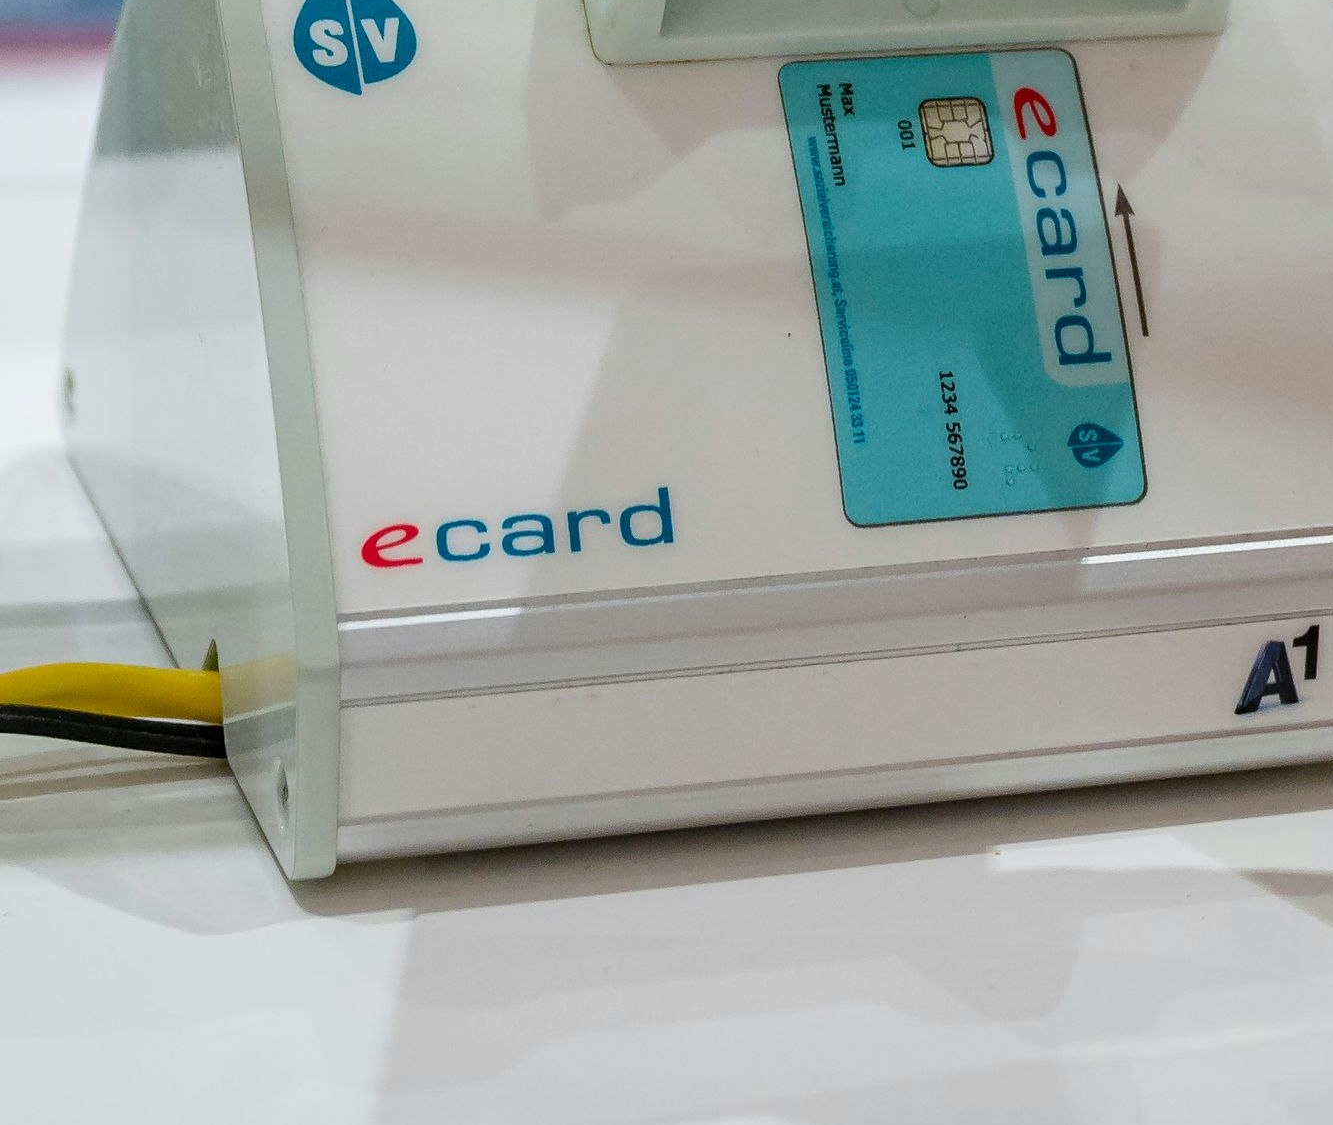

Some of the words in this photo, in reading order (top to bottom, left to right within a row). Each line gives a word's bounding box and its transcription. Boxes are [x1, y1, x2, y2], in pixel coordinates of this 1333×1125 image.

[310, 18, 400, 67] SV
[838, 82, 855, 116] Max
[816, 83, 846, 186] Mustermann
[897, 119, 916, 151] 001
[938, 370, 958, 415] 1234
[946, 422, 969, 491] 567890
[1233, 624, 1320, 715] A1
